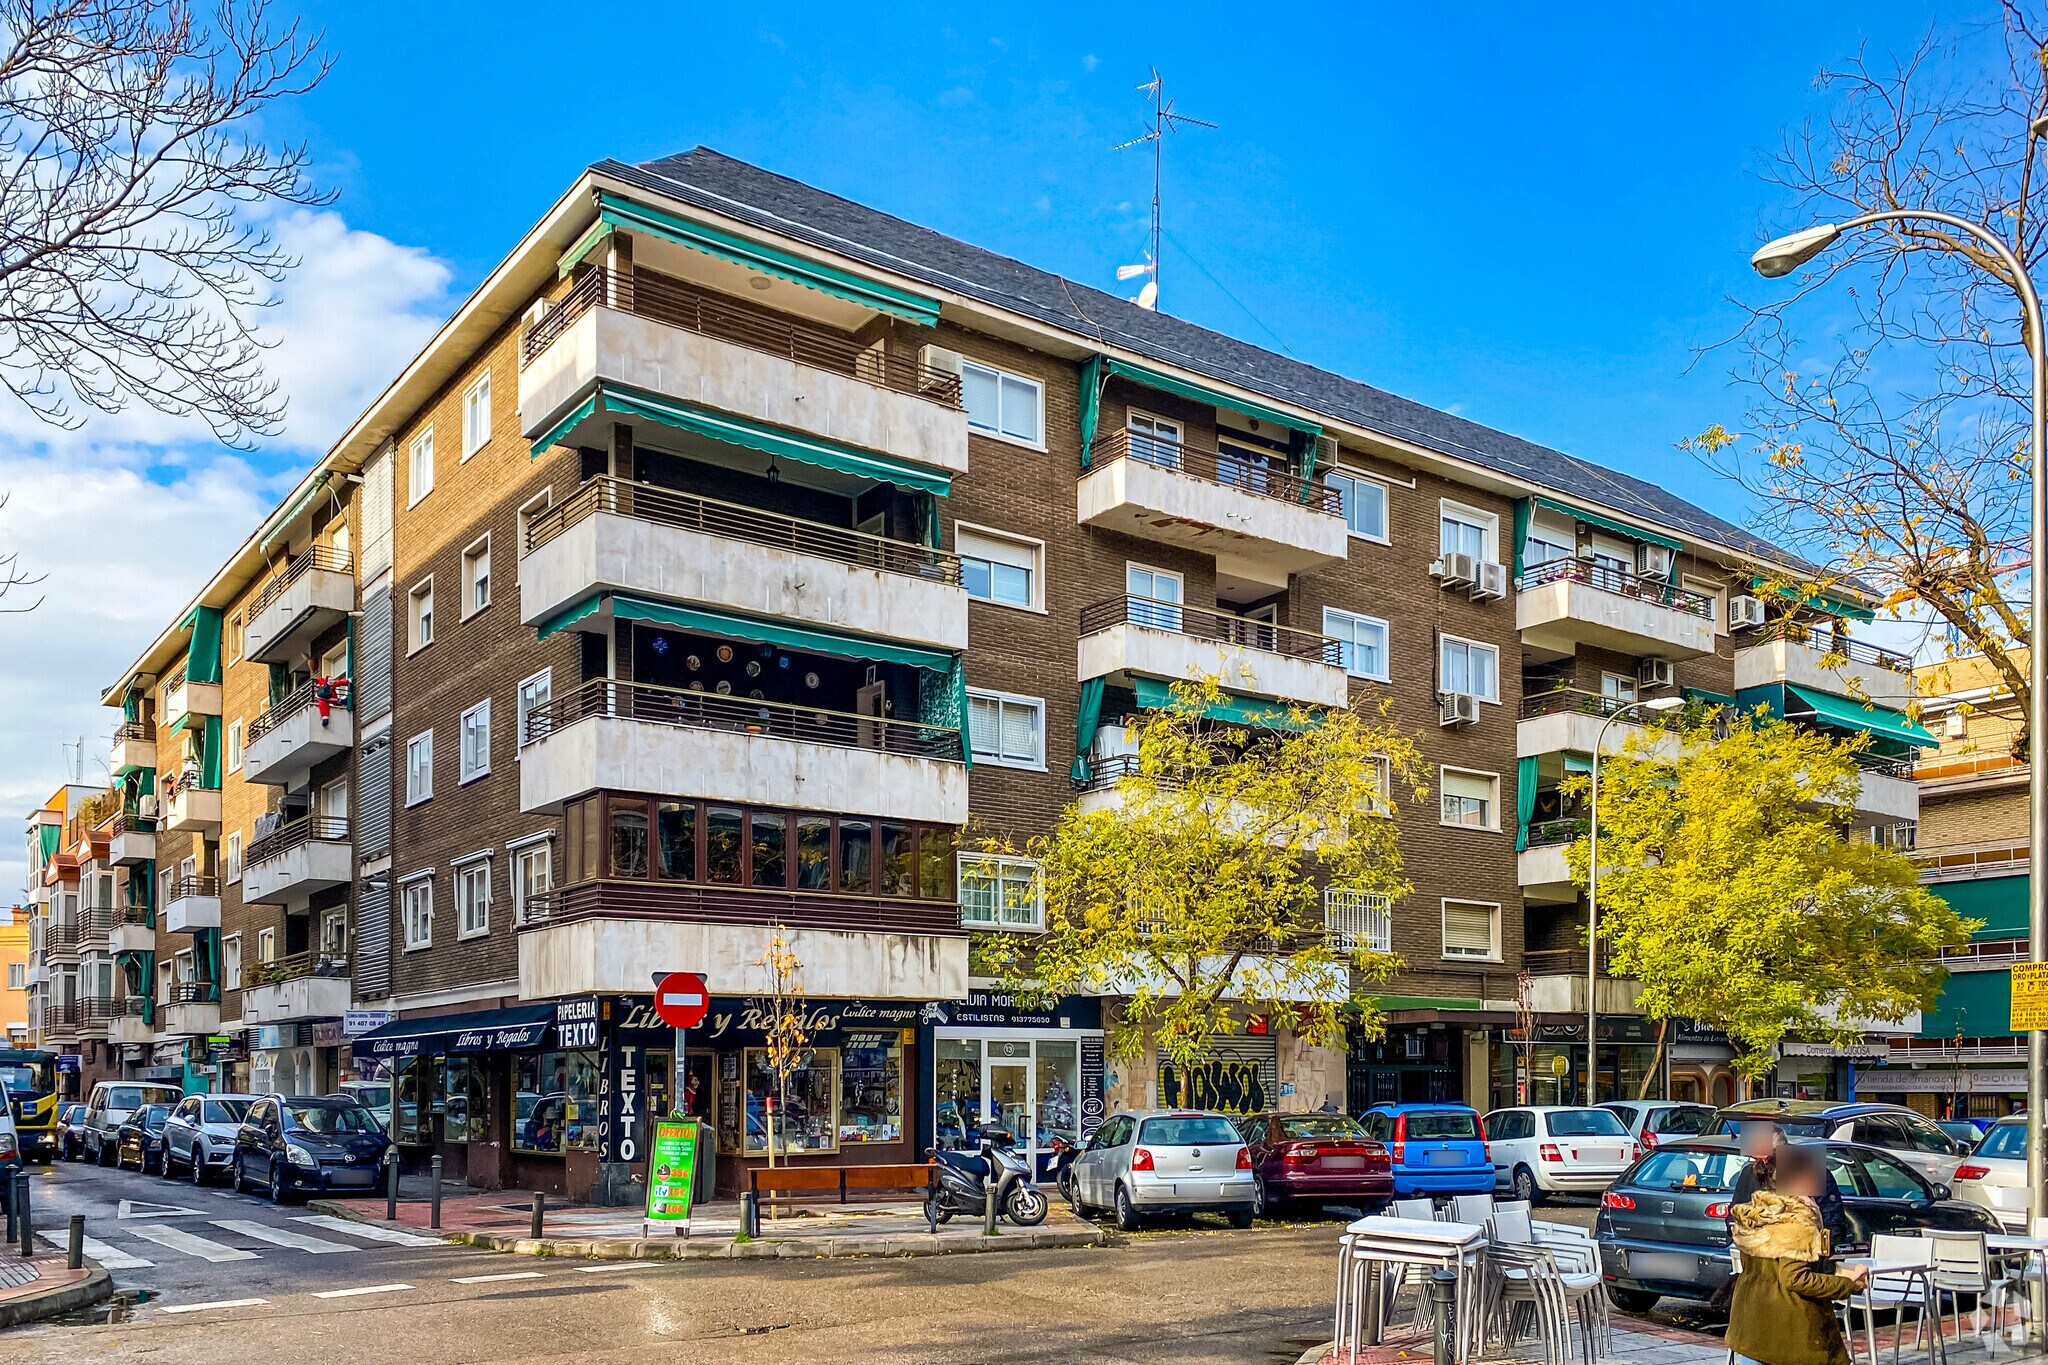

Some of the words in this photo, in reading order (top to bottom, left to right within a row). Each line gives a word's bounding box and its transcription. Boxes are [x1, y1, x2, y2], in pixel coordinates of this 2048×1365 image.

[557, 1001, 596, 1020] PAPELERIA
[879, 1009, 916, 1021] magno
[956, 1013, 1005, 1022] ESTILISTAS
[619, 1005, 707, 1029] Libs
[709, 1013, 733, 1038] y
[456, 1032, 483, 1046] Libros
[485, 1034, 493, 1049] y
[496, 1028, 531, 1048] Regalos
[558, 1022, 596, 1046] TEXTO
[395, 1041, 419, 1055] magno
[1005, 1045, 1013, 1054] 13
[1805, 1045, 1837, 1055] Comercial
[1867, 1073, 1893, 1083] tienda
[1896, 1073, 1907, 1083] de
[600, 1036, 609, 1157] LIBROS
[620, 1046, 636, 1160] TEXTO
